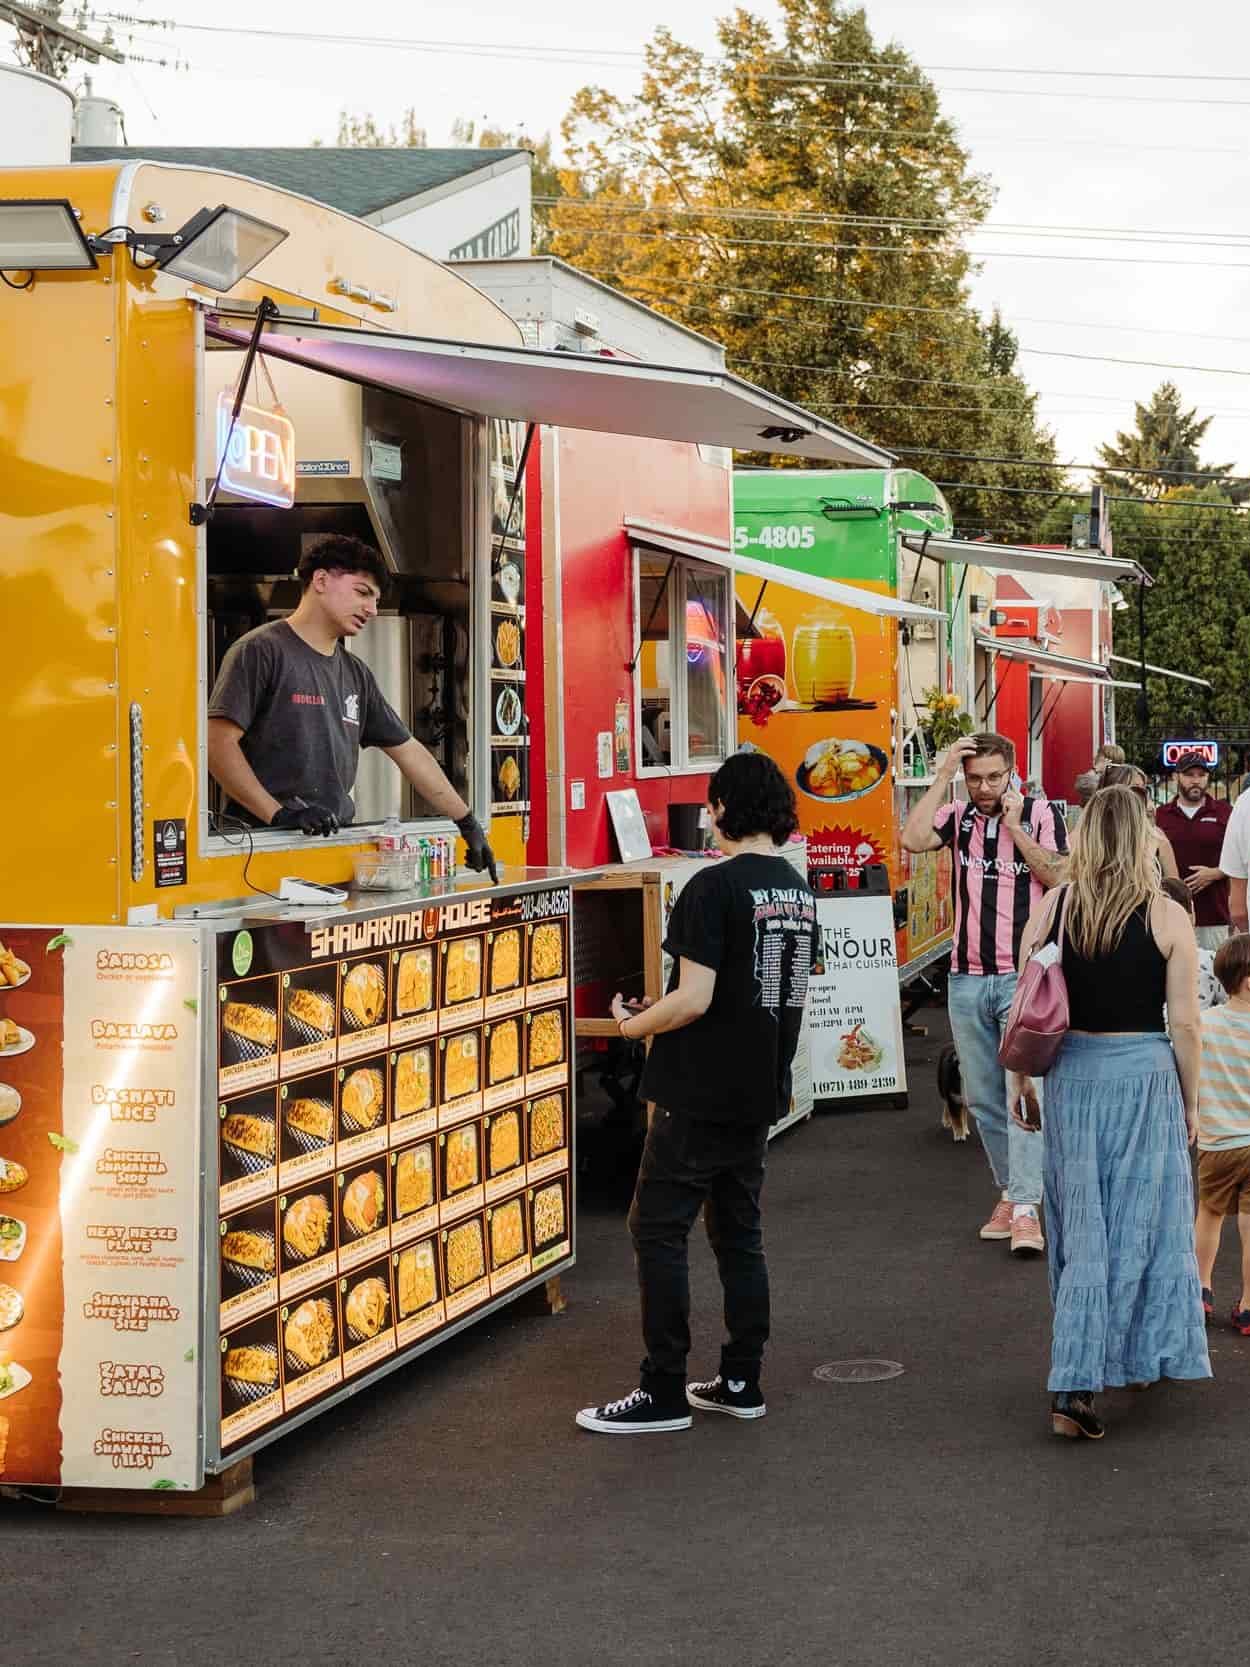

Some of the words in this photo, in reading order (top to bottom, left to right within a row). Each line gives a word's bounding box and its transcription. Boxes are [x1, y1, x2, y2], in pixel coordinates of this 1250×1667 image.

[227, 424, 290, 485] OPEN
[735, 526, 815, 549] 5-4805
[808, 855, 855, 865] Available
[995, 858, 1031, 875] Days
[521, 890, 569, 921] 503-496-8526
[311, 910, 423, 959] SHAWARMA
[438, 898, 492, 931] HOUSE
[824, 928, 851, 939] THE
[825, 938, 893, 960] NOUR
[97, 949, 174, 970] SAMOSA
[827, 960, 852, 970] THAI
[856, 959, 897, 969] CUISINE
[91, 1020, 178, 1040] BAKLAVA
[91, 1084, 176, 1106] BASMATI
[819, 1080, 845, 1094] (971)
[111, 1103, 157, 1121] RICE
[104, 1148, 161, 1162] CHICKEN
[96, 1159, 168, 1175] SHAWARMA
[116, 1172, 148, 1185] SIDE
[86, 1225, 126, 1239] MEAT
[107, 1239, 152, 1253] PLATE
[92, 1291, 170, 1310] SHAWARMA
[114, 1318, 149, 1331] SIZE
[99, 1360, 165, 1382] ZATAR
[100, 1377, 164, 1397] SALAD
[102, 1428, 164, 1444] CHICKEN
[94, 1439, 172, 1457] SHAWARMA
